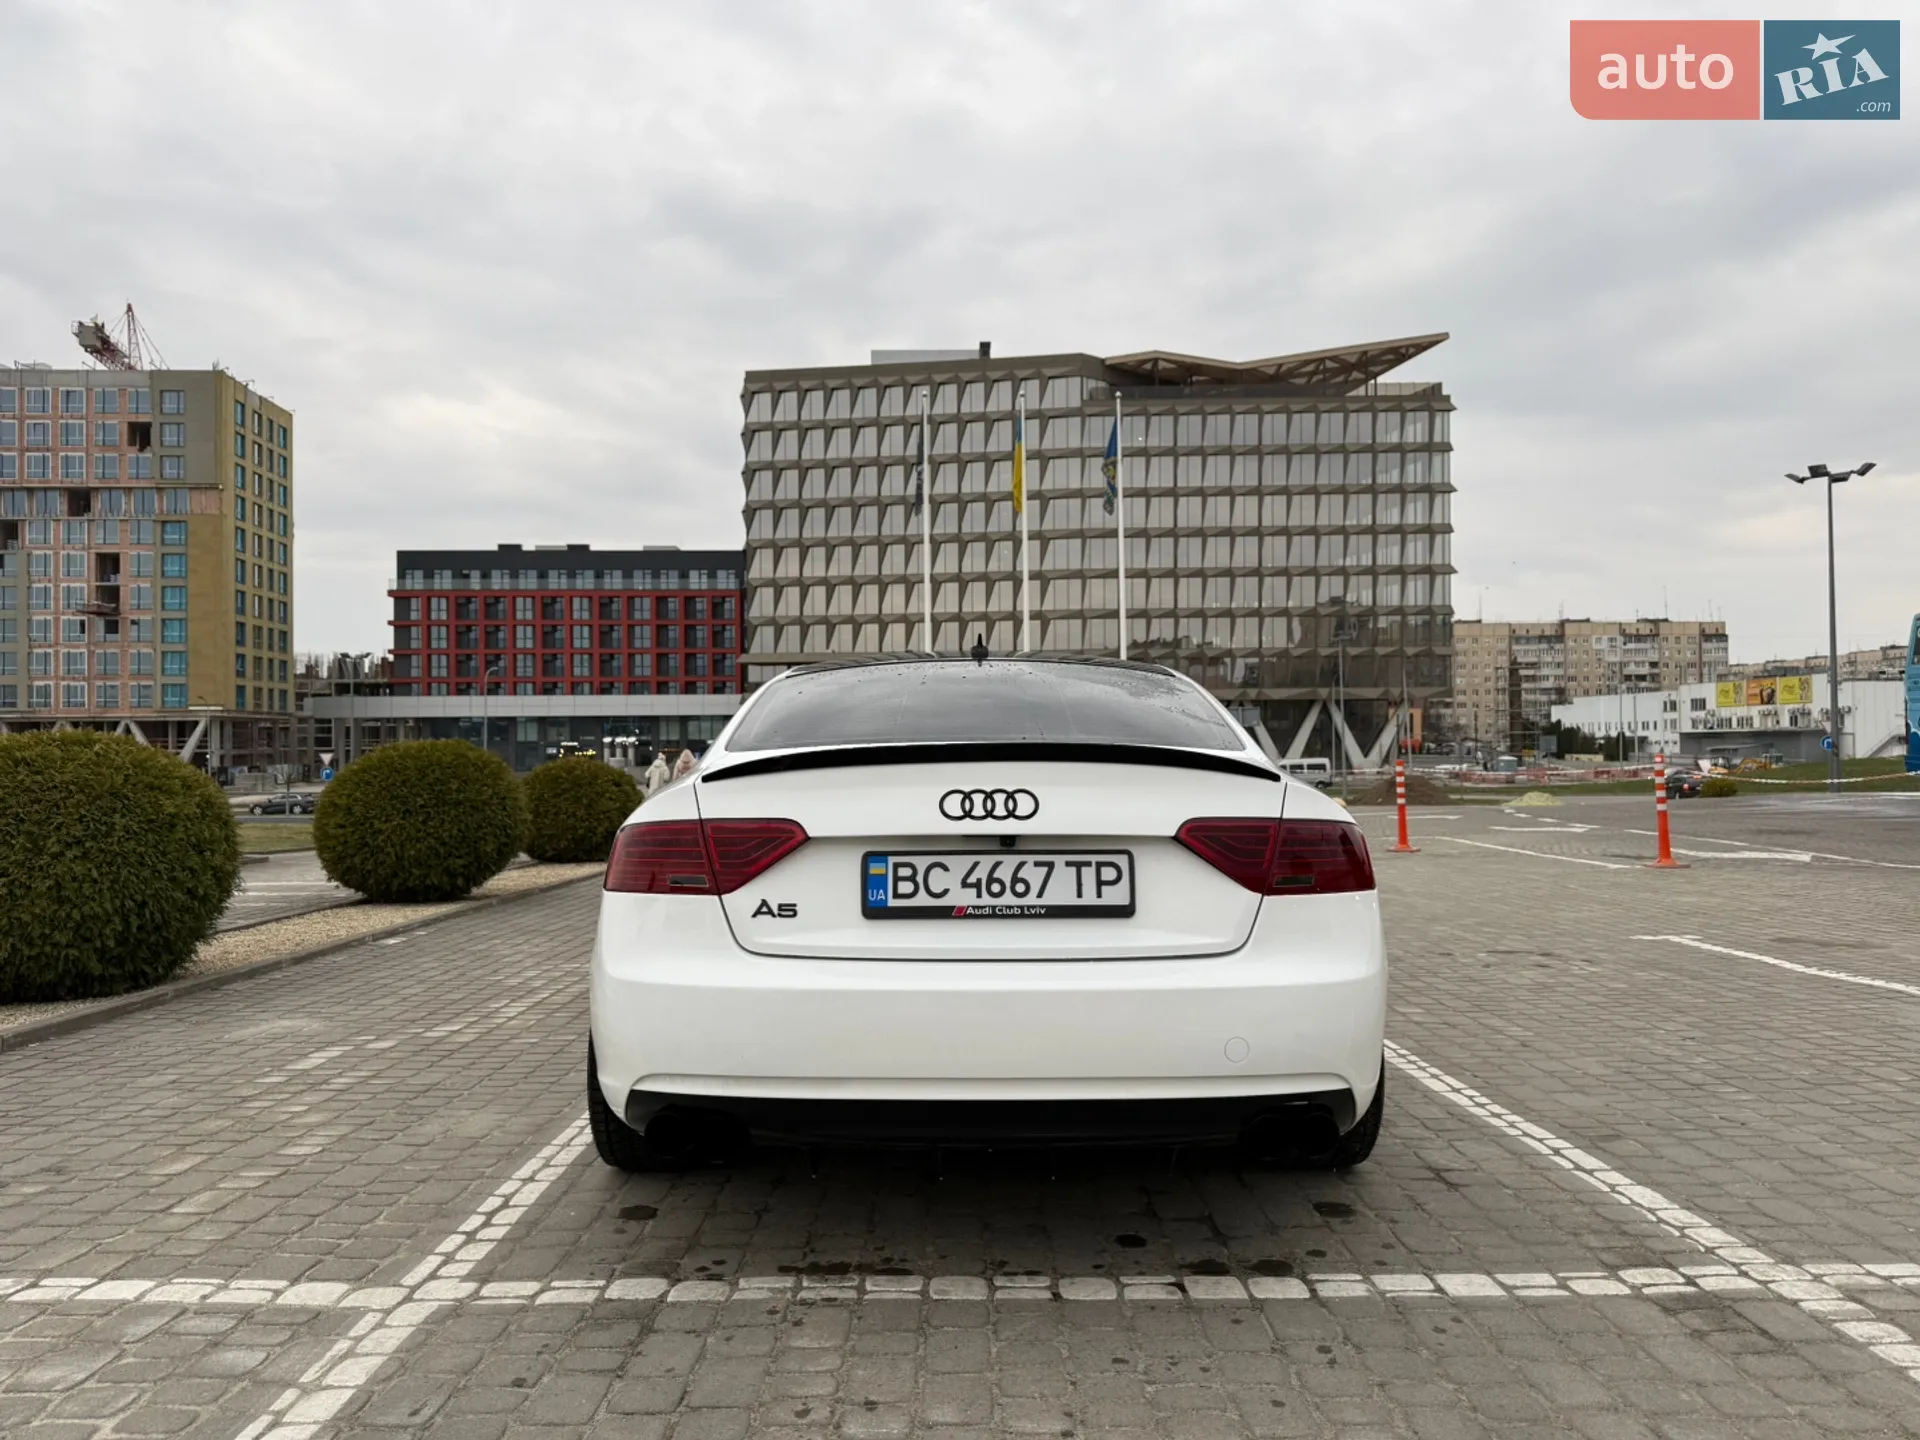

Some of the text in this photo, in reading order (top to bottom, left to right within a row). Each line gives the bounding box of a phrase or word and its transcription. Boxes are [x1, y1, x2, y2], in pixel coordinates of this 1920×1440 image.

[892, 860, 1123, 899] BC 4667 TP
[868, 889, 886, 901] UA
[751, 898, 798, 918] A5
[966, 905, 1047, 915] Audi Club Lviv
